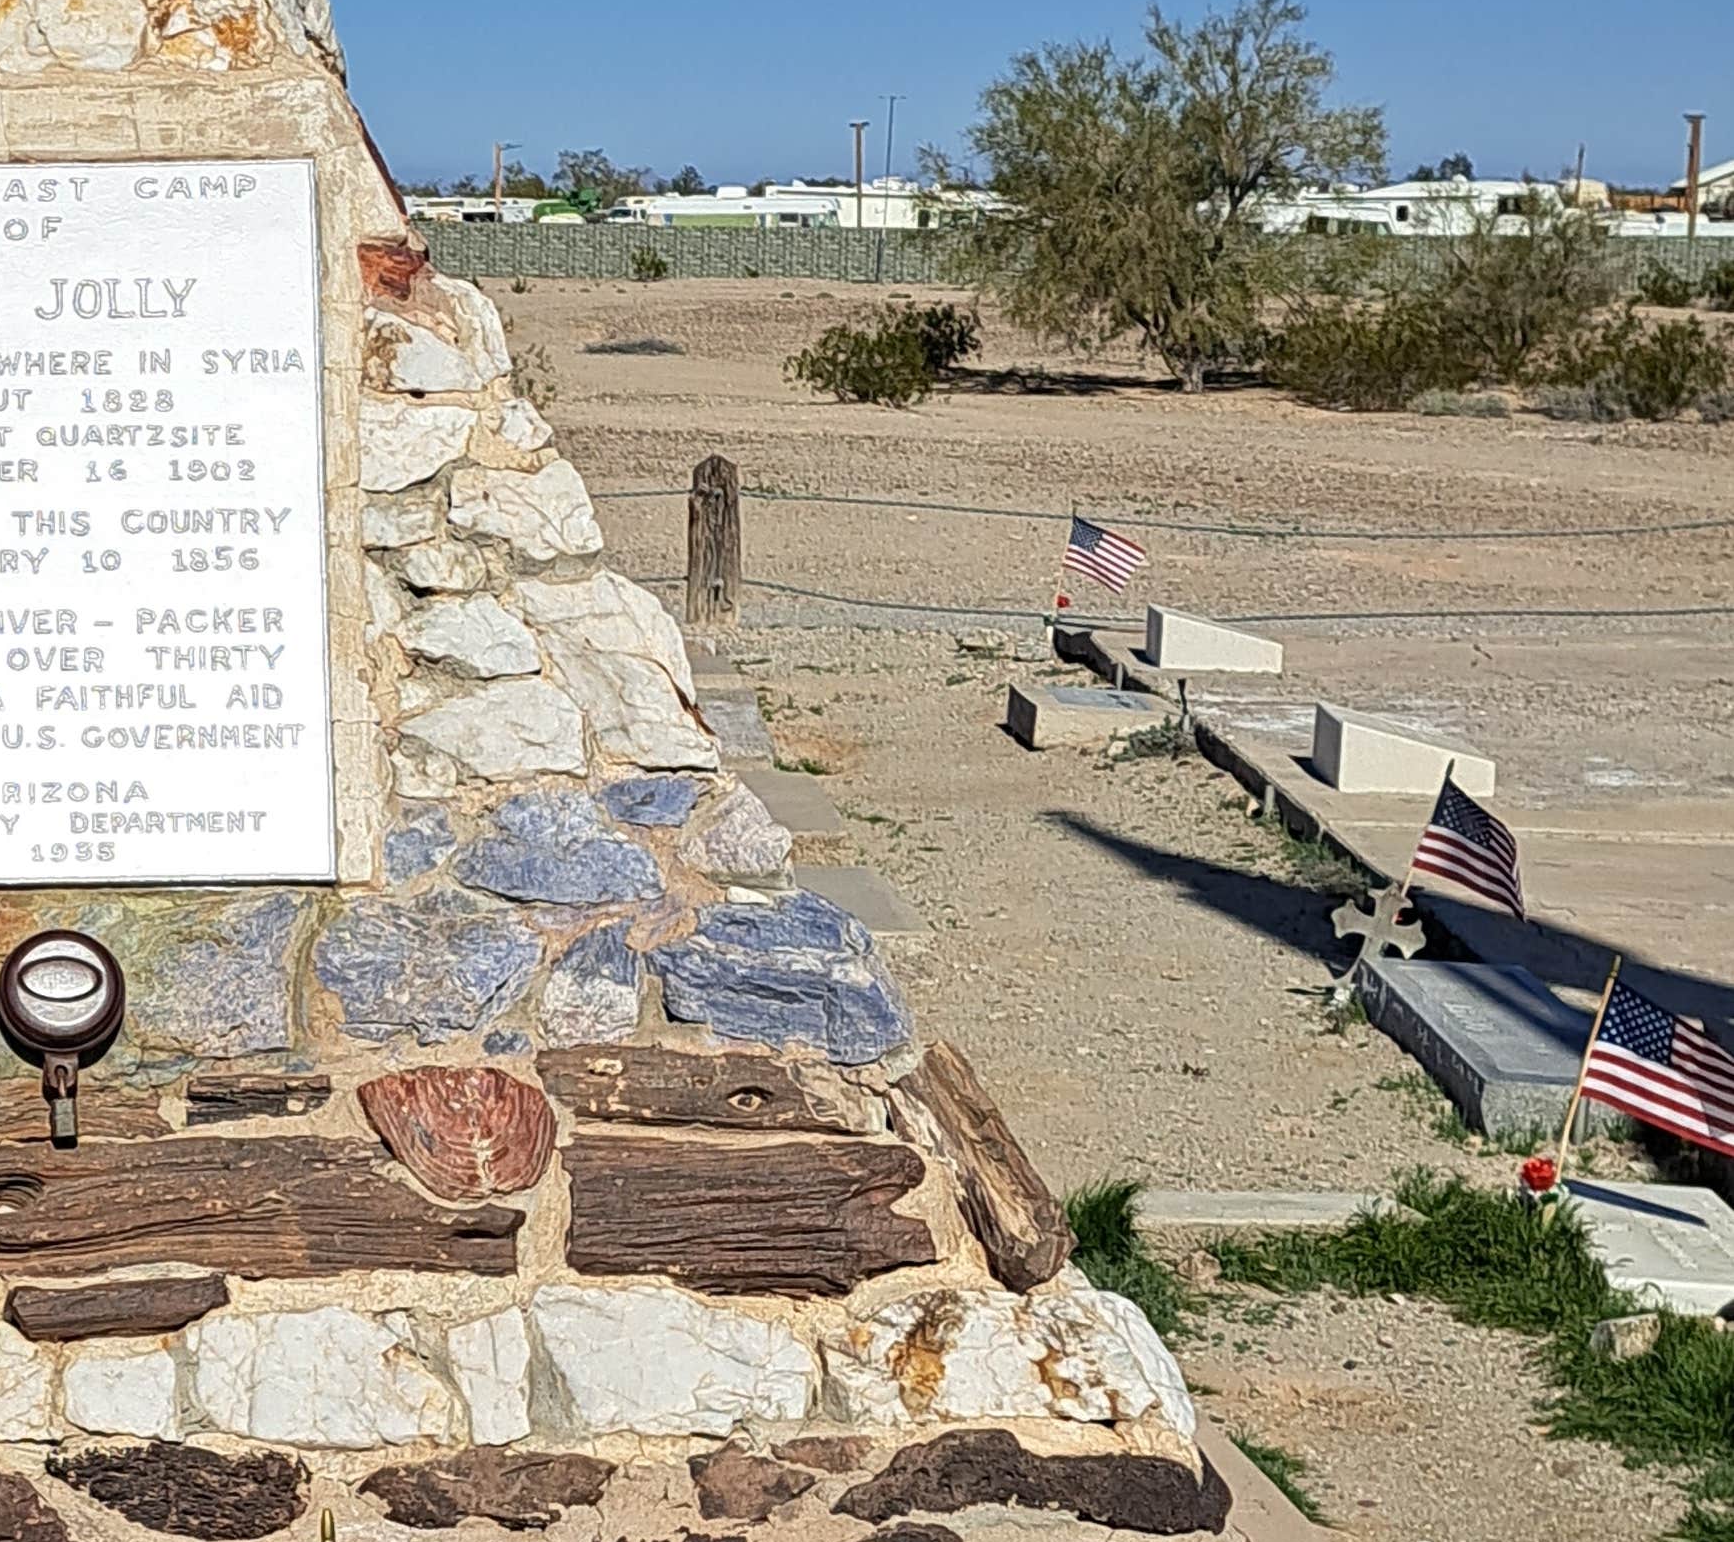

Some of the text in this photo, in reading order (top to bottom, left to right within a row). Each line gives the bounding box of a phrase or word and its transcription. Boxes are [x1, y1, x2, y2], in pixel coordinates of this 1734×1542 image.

[134, 175, 257, 200] CAMP
[4, 217, 62, 241] OF
[35, 278, 196, 320] JOLLY
[139, 349, 170, 374] IN
[202, 349, 305, 374] SYRIA
[80, 389, 175, 413] 1828
[36, 423, 245, 447] QUARTZSITE
[85, 460, 128, 483] 16
[168, 459, 255, 482] 1902
[12, 510, 90, 537] THIS
[121, 507, 291, 535] COUNTRY
[82, 550, 121, 572] 10
[173, 547, 259, 571] 1856
[137, 607, 284, 634] PACKER
[6, 648, 104, 673] OVER
[146, 644, 285, 671] THIRTY
[37, 684, 196, 711] FAITHFUL
[226, 684, 283, 710] AID
[2, 726, 65, 749] U.S.
[80, 722, 305, 749] GOVERNMENT
[70, 810, 266, 835] DEPARTMENT
